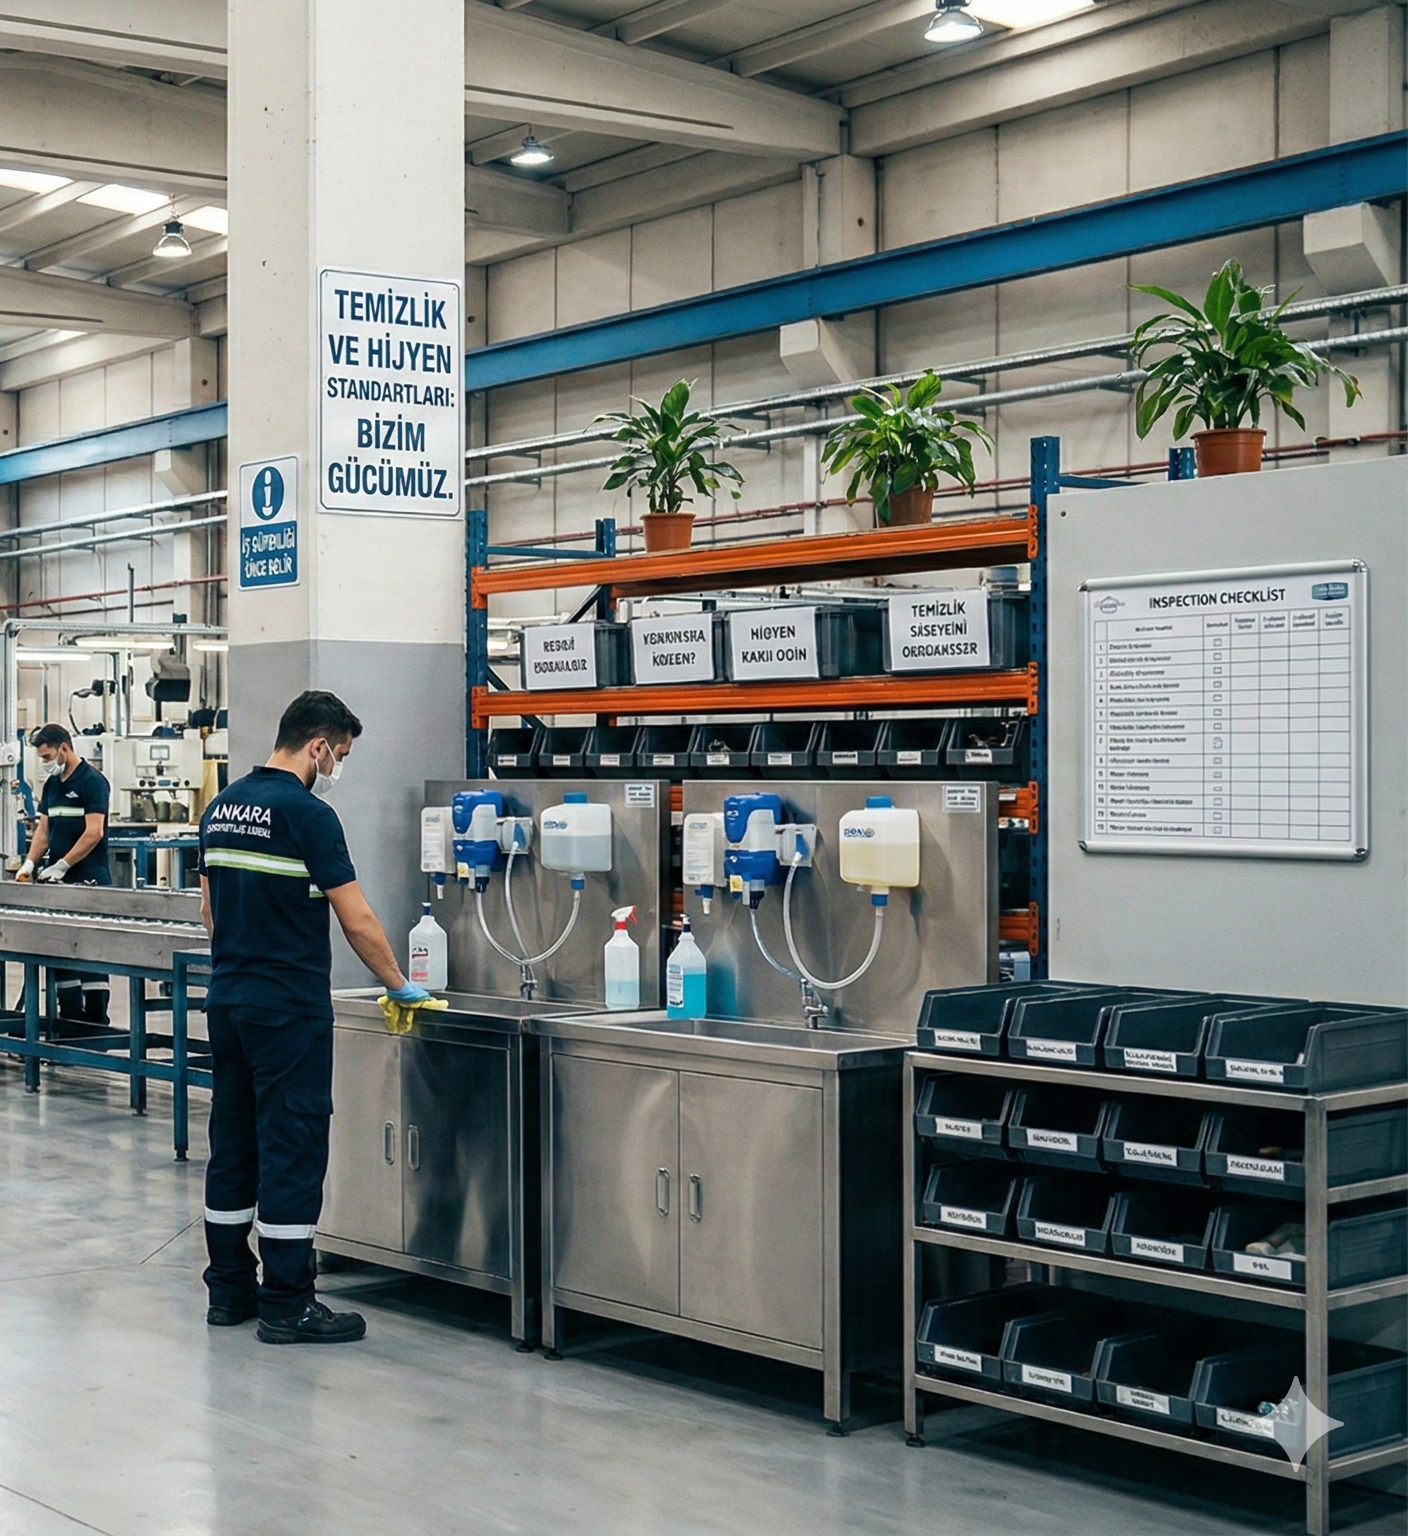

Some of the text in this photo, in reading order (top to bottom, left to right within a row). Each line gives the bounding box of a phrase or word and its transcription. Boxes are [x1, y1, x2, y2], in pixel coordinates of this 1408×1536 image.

[334, 288, 447, 329] TEMİZLİK
[328, 332, 452, 374] VE HİJYEN
[327, 377, 455, 408] STANDARTLARI:
[357, 412, 426, 452] BİZİM
[328, 456, 454, 499] GÜCÜMÜZ.
[911, 598, 966, 618] TEMİZLİK
[1149, 592, 1217, 609] INSPECTION
[210, 803, 271, 826] ANKARA
